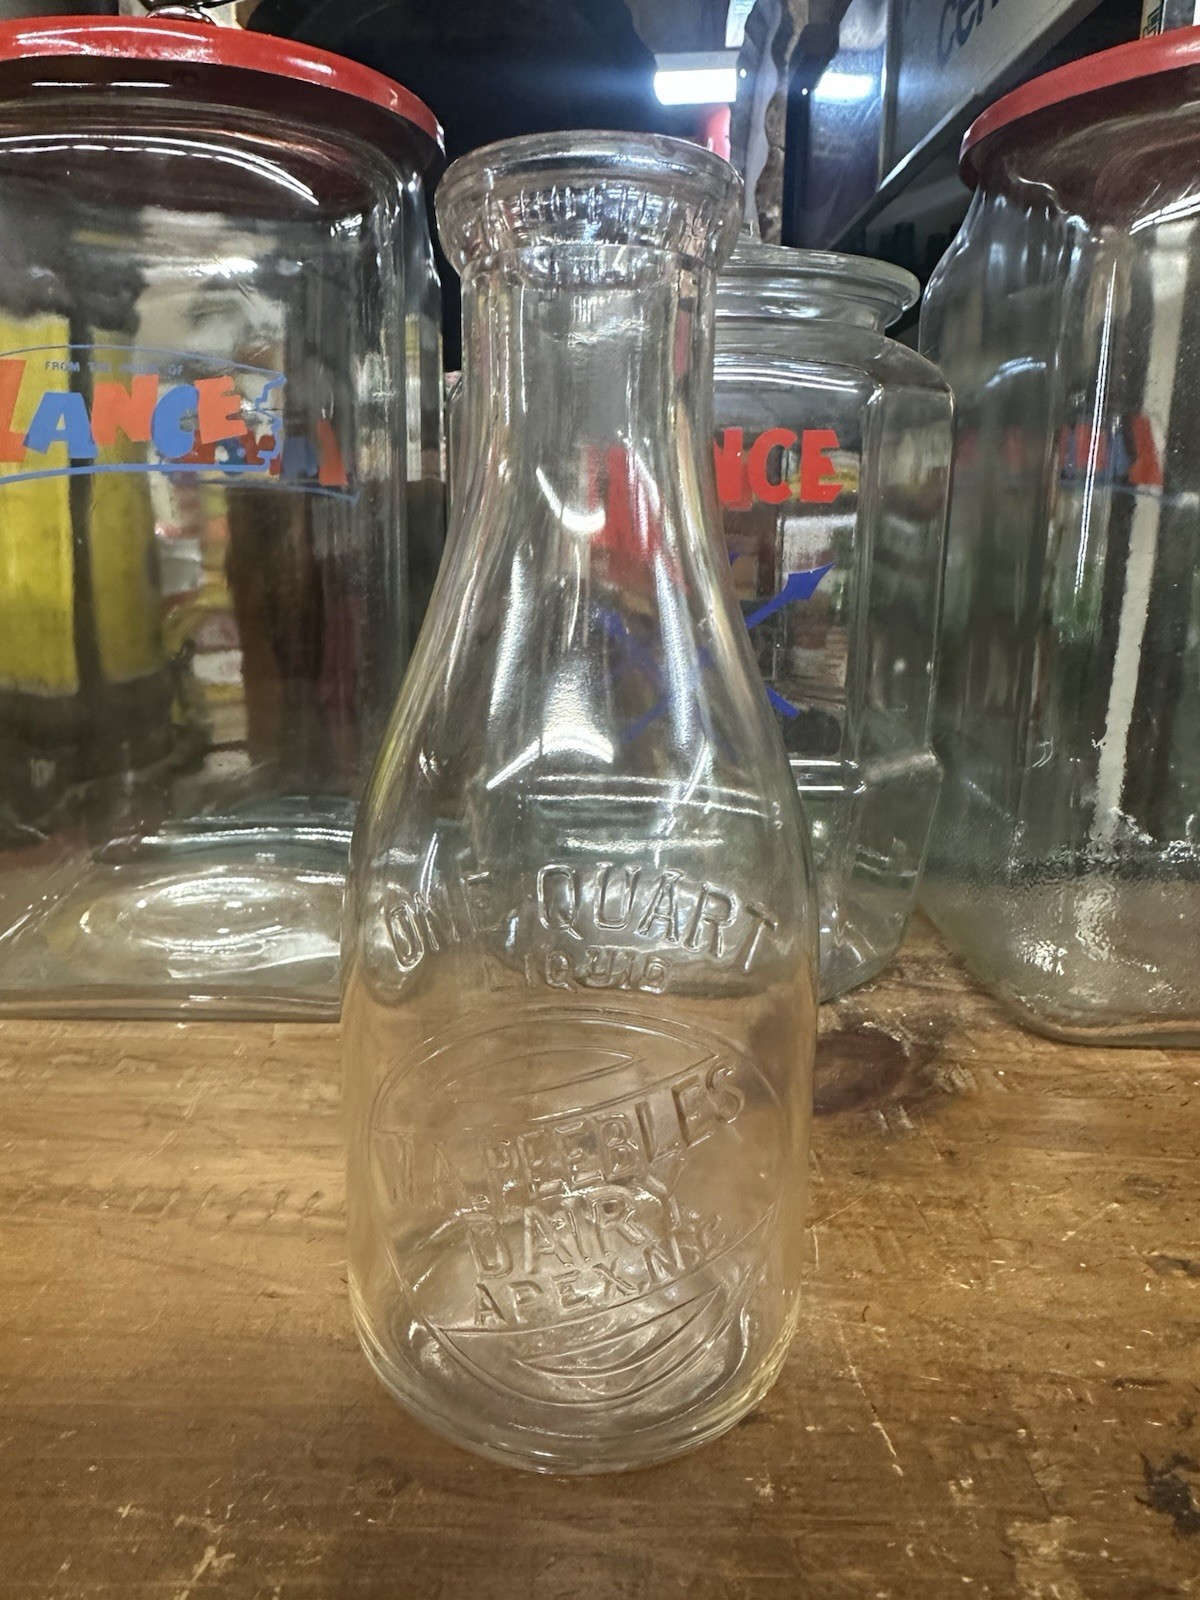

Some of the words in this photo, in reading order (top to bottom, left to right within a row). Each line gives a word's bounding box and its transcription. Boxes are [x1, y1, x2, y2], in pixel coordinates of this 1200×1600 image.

[45, 361, 80, 374] FROM
[0, 360, 249, 459] LANCE
[536, 862, 779, 972] QUART
[472, 1262, 640, 1328] APEX
